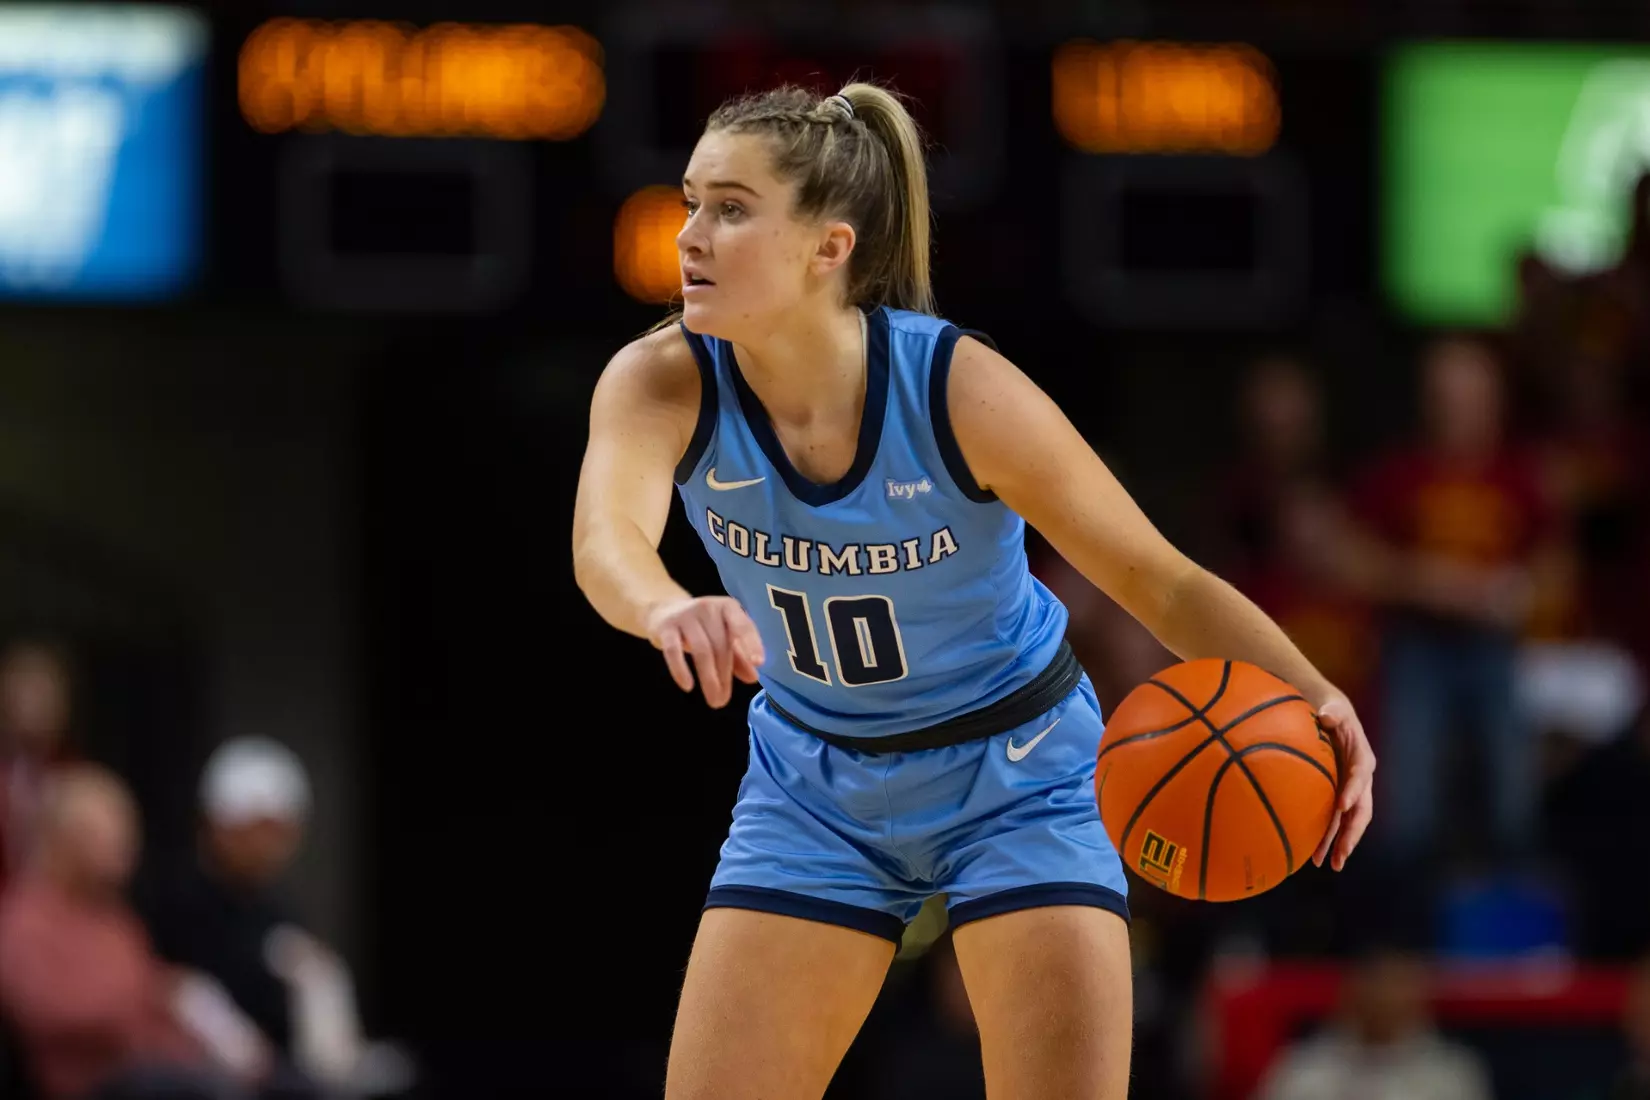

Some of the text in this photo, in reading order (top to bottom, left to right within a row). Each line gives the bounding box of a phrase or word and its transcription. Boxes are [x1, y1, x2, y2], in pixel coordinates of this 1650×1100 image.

[887, 481, 916, 500] Ivy
[706, 506, 959, 576] COLUMBIA
[766, 583, 909, 688] 10
